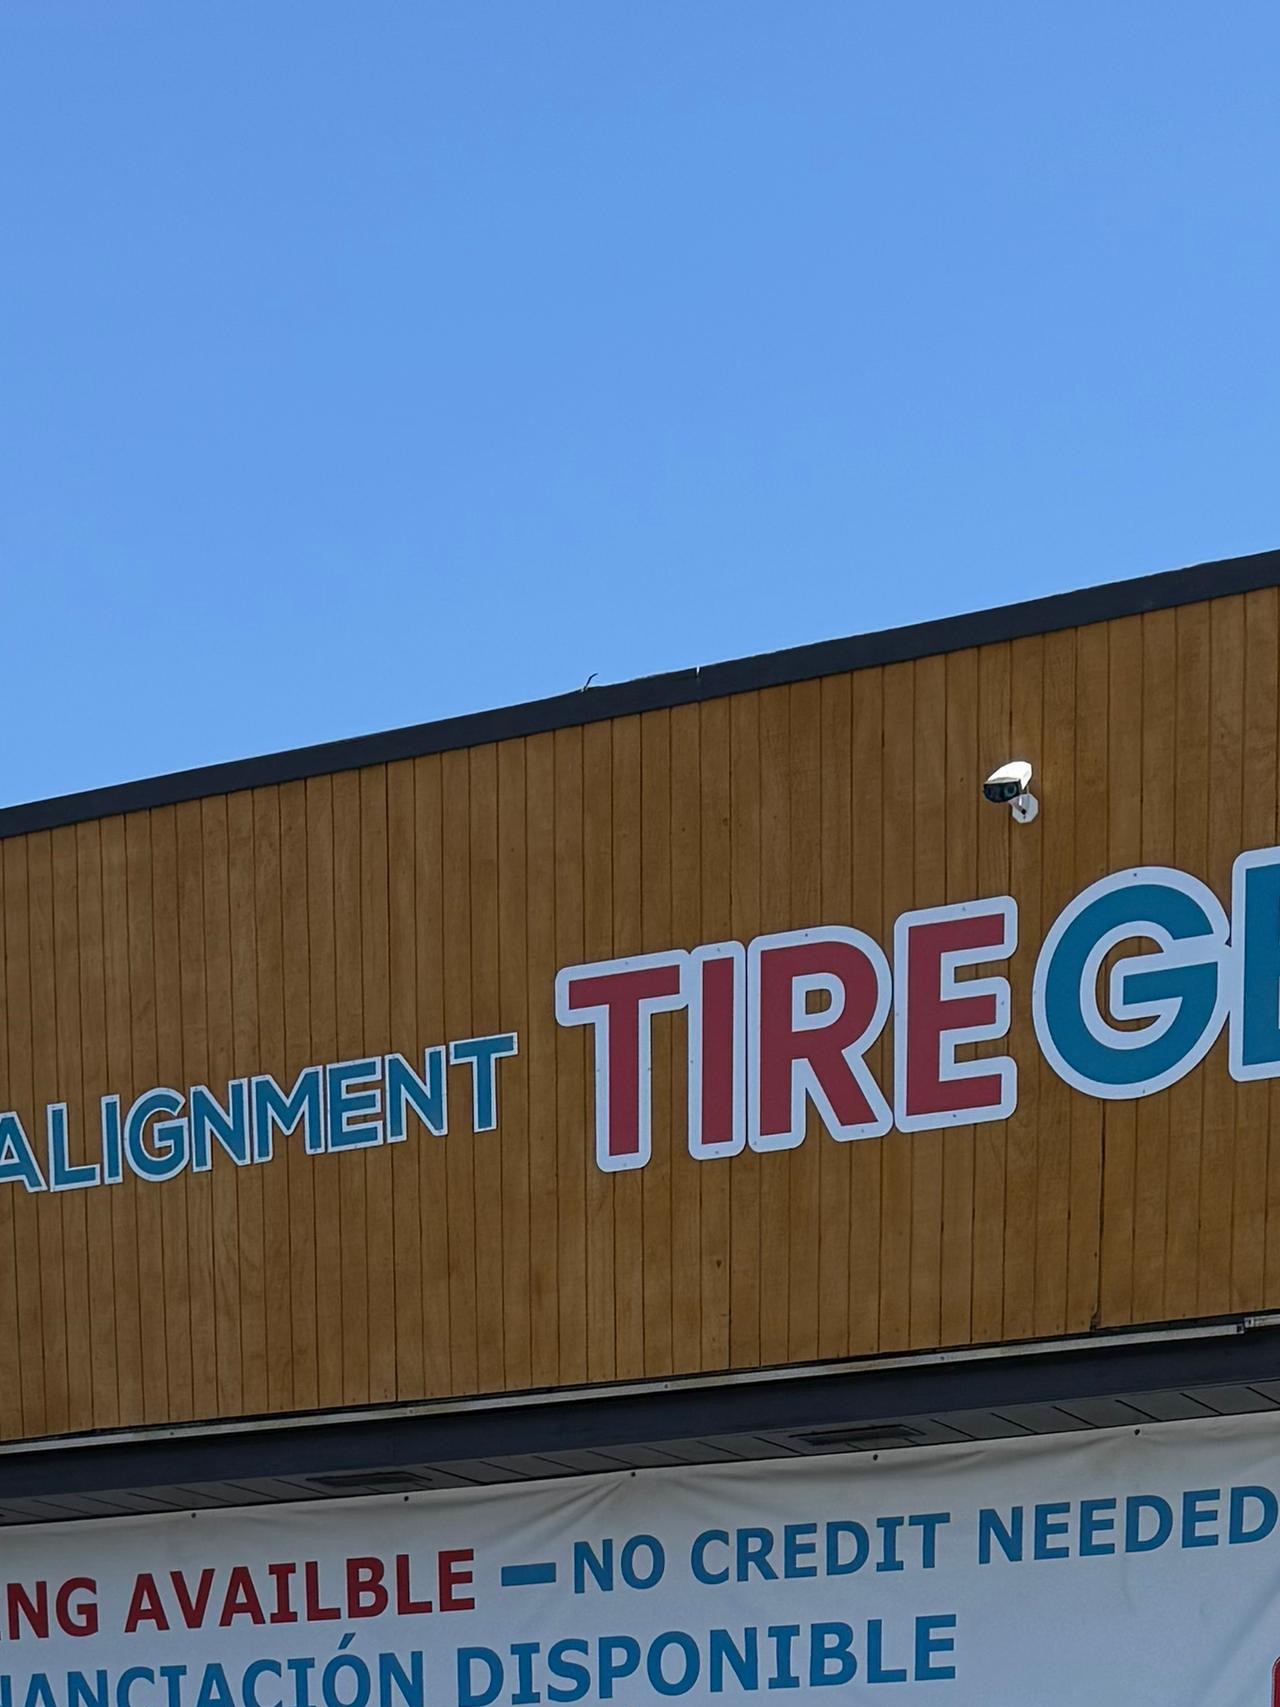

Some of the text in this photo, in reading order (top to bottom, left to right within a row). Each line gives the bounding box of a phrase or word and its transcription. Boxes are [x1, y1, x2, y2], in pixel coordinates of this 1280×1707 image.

[125, 1548, 476, 1634] AVAILBLE
[573, 1535, 666, 1593] NO
[691, 1513, 950, 1585] CREDIT
[979, 1485, 1279, 1565] NEEDED
